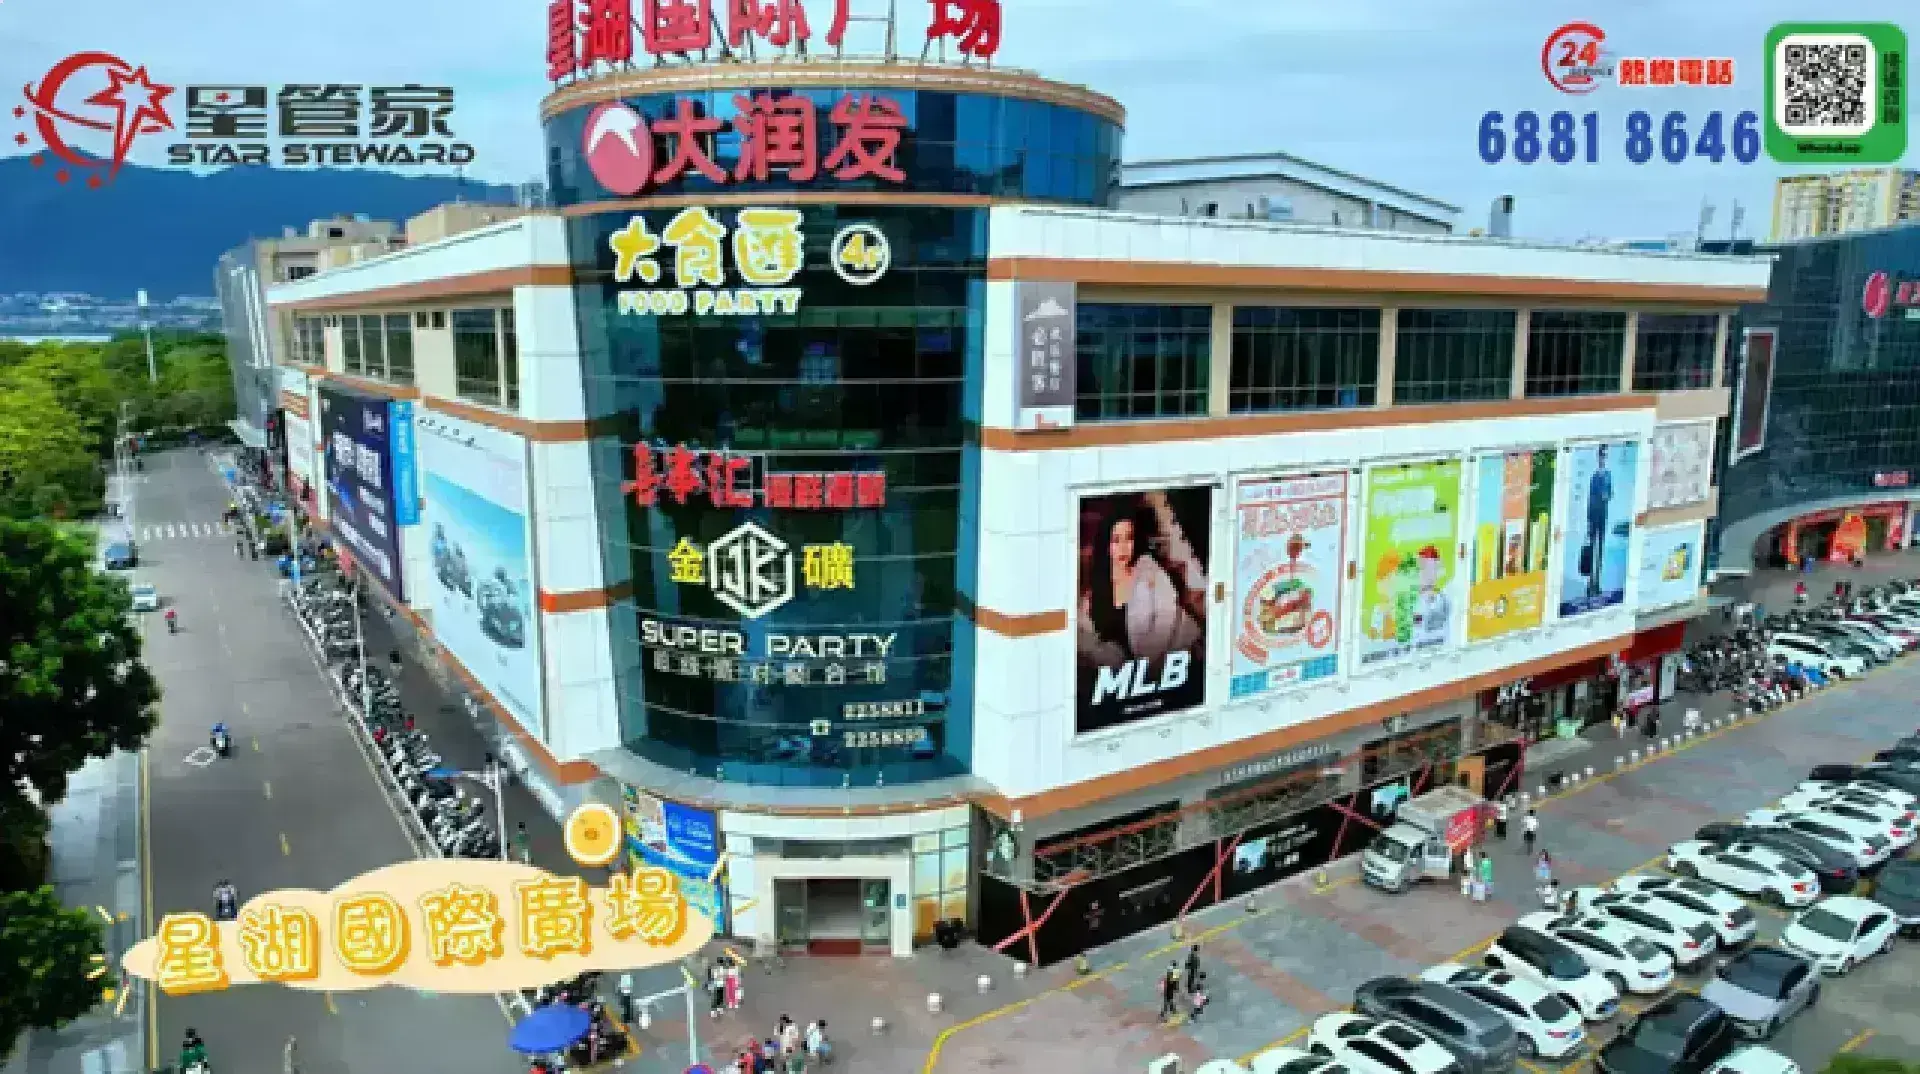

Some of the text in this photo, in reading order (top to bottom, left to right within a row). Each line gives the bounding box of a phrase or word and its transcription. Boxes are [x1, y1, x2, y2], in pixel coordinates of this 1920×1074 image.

[652, 92, 908, 183] 大润发
[616, 287, 804, 316] FOOD PARTY
[667, 536, 704, 584] 金
[641, 618, 898, 658] SUPER PARTY
[1091, 650, 1192, 706] MLB
